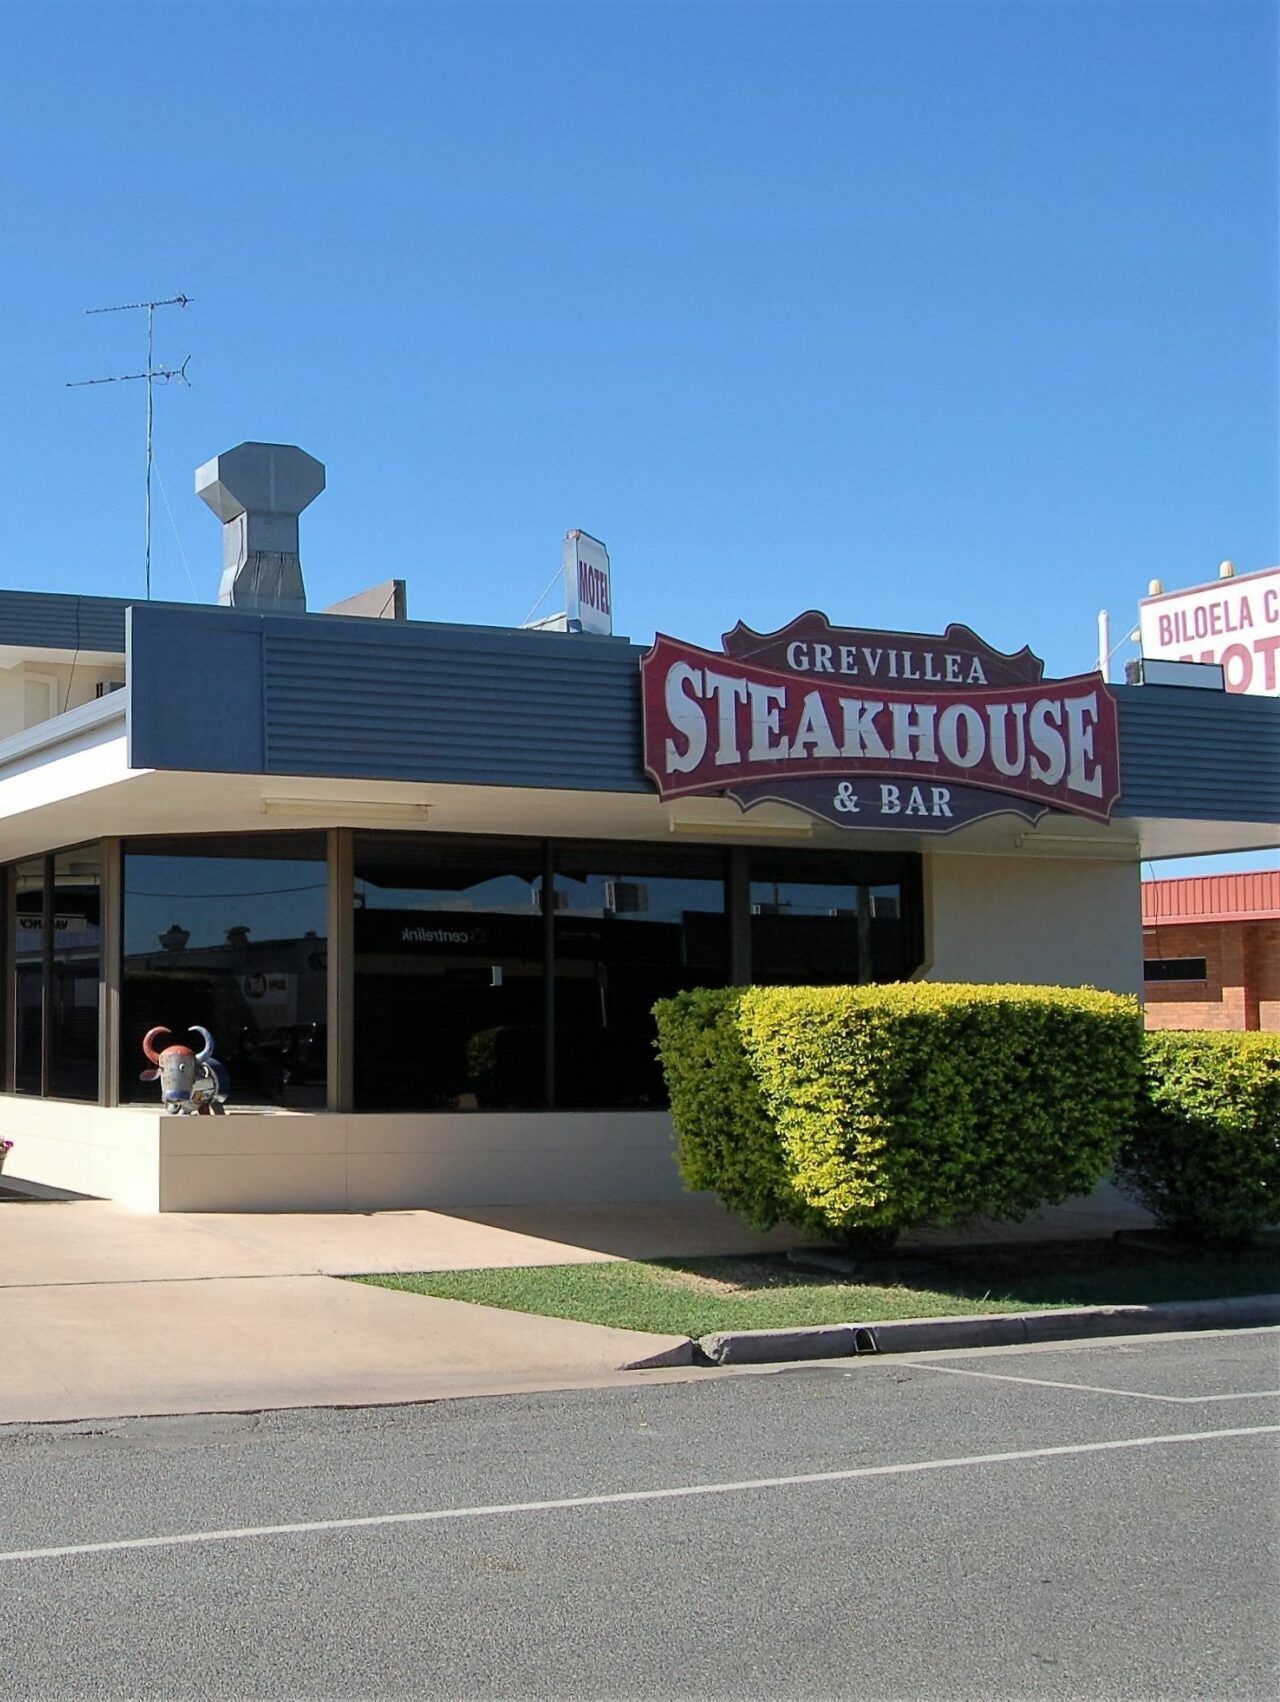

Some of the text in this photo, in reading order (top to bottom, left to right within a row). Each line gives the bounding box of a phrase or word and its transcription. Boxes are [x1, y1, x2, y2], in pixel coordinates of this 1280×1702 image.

[579, 560, 609, 615] MOTEL
[1158, 595, 1254, 646] BILOELA
[786, 641, 988, 685] GREVILLEA
[664, 661, 1104, 798] STEAKHOUSE
[832, 782, 953, 817] & BAR
